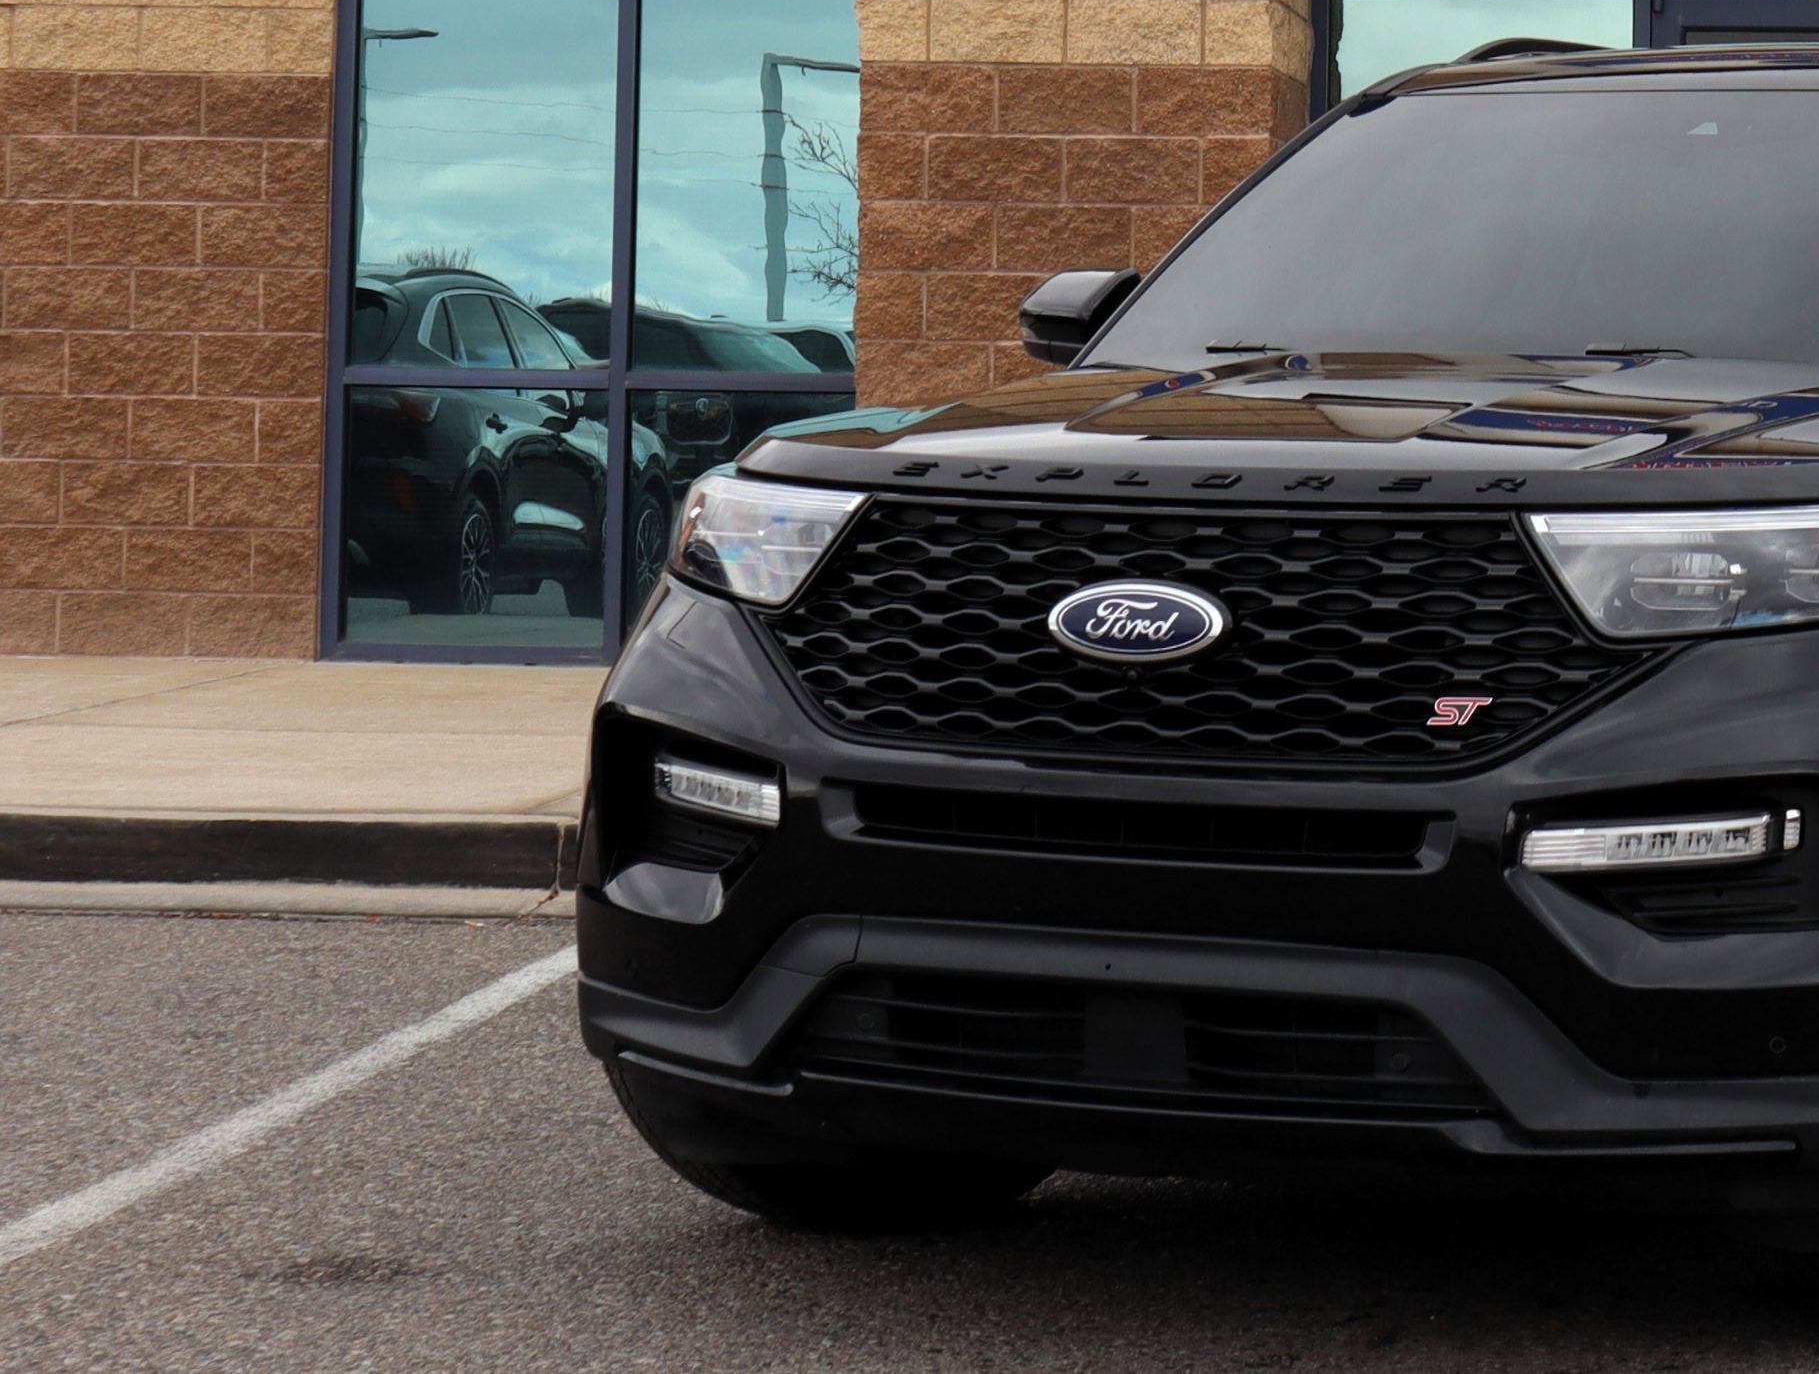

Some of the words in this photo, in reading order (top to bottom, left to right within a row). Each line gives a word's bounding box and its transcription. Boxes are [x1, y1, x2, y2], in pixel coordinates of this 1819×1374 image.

[893, 462, 1527, 493] EXPLORER
[1085, 598, 1180, 641] Ford
[1426, 696, 1493, 726] ST
